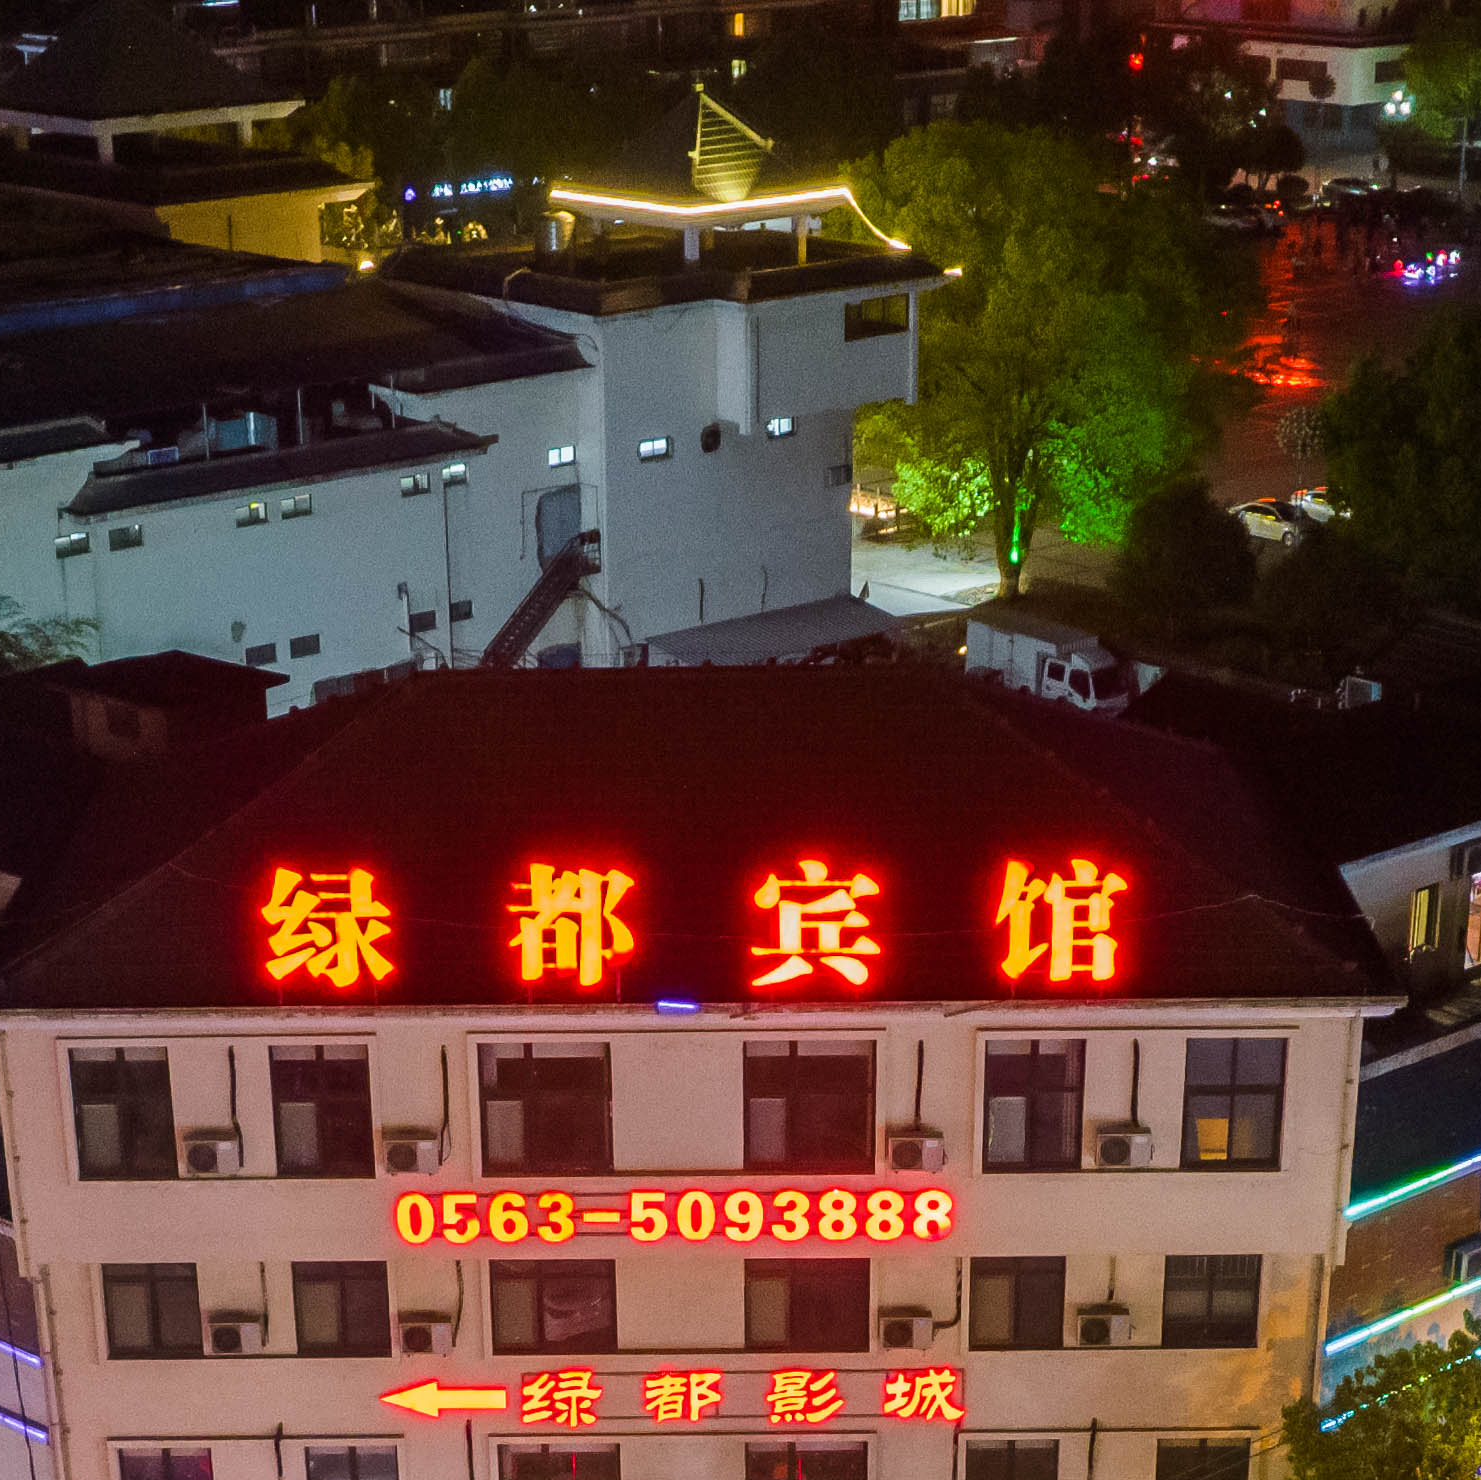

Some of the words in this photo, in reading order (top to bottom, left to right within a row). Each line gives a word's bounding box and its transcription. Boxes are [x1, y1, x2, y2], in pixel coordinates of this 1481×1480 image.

[260, 859, 1130, 988] 绿都宾馆
[395, 1189, 955, 1243] 0563-5093888
[521, 1366, 966, 1428] 绿都影城
